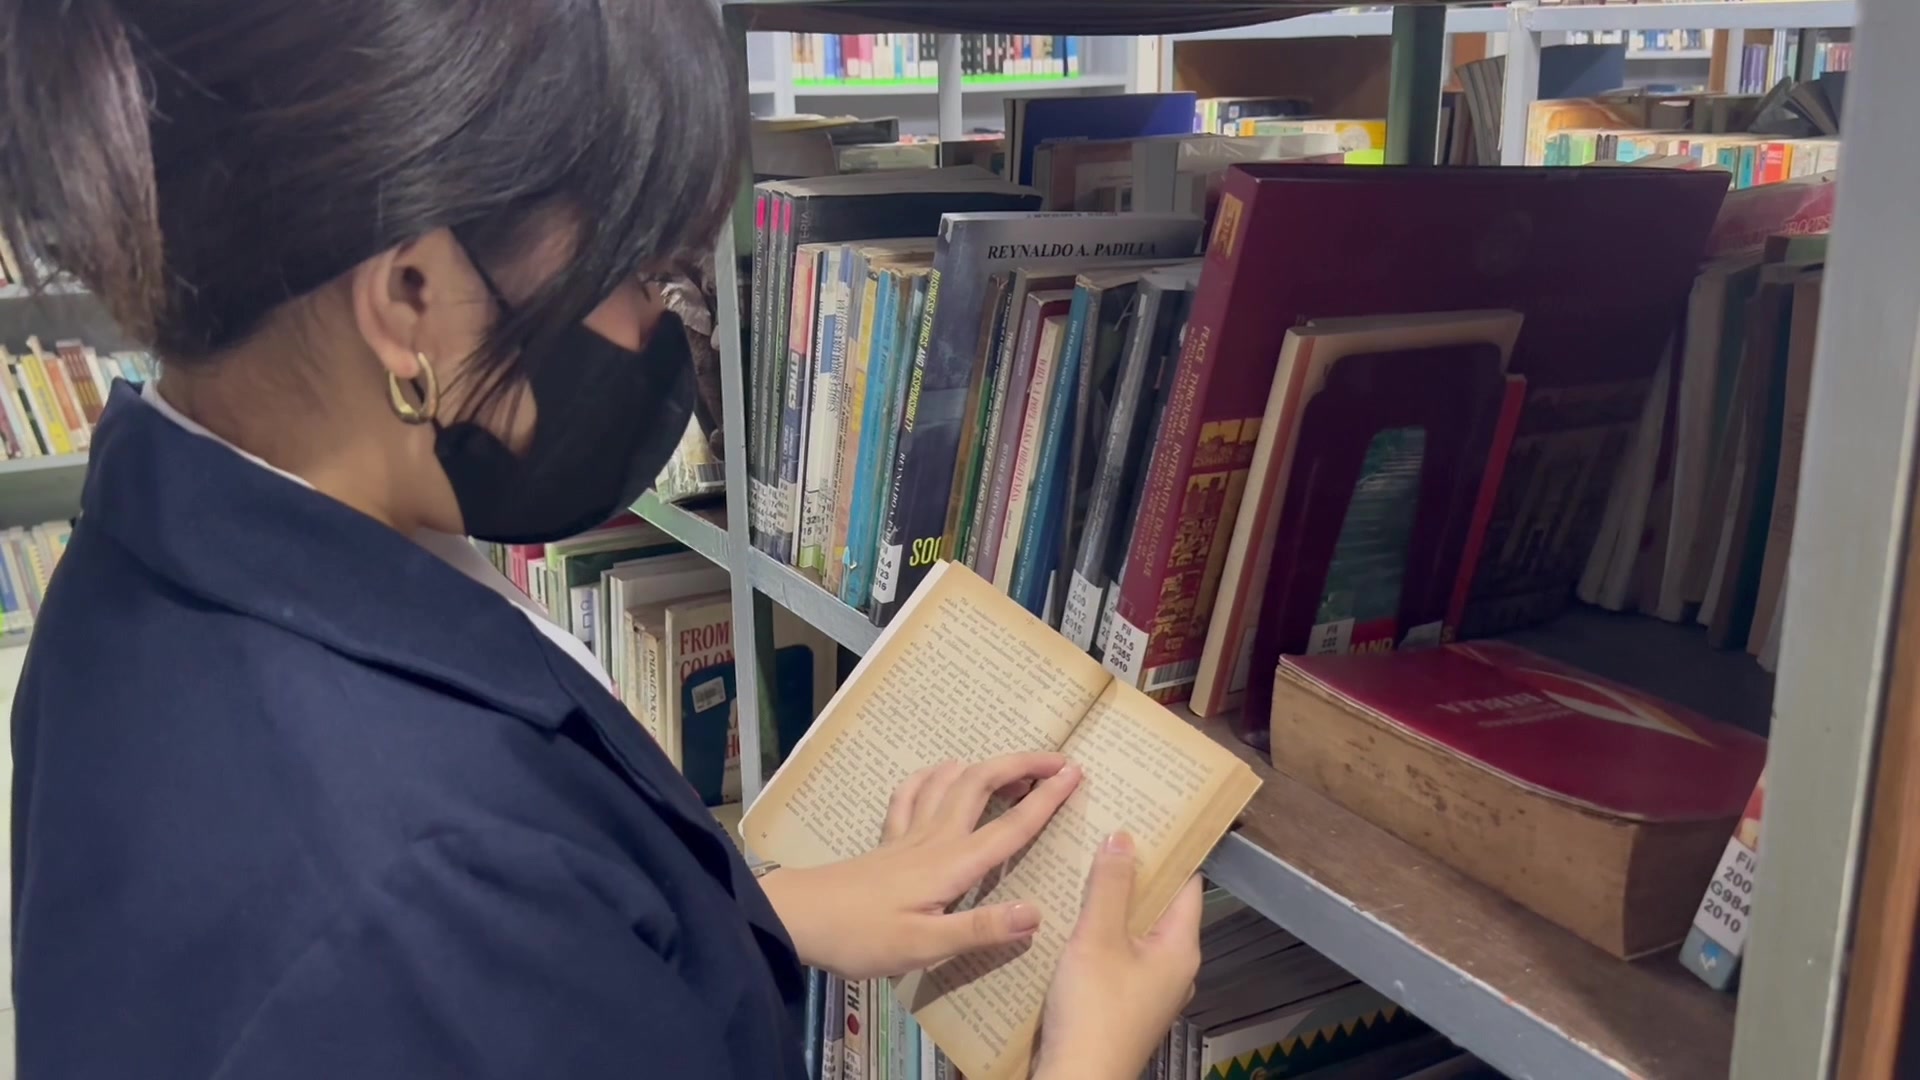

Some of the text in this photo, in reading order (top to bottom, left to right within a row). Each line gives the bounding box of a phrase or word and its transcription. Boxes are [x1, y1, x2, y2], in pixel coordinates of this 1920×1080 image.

[987, 242, 1157, 260] REYNALDO A. PADILLA
[925, 269, 940, 313] BUSINESS
[919, 314, 932, 347] ETHICS
[1004, 330, 1014, 349] THE
[915, 345, 927, 366] AND
[997, 350, 1010, 389] MERGING
[786, 351, 801, 408] ETHICS
[987, 390, 1002, 443] PHILOSOPHY
[1026, 397, 1040, 421] POPE
[984, 445, 993, 459] OF
[1141, 326, 1210, 578] PEACE THROUGH INTERFAITH DIALOGUE
[888, 452, 907, 508] REYNALDO
[980, 460, 990, 480] EAST
[977, 482, 986, 499] AND
[1078, 580, 1088, 592] Fil
[680, 621, 729, 656] FROM
[1122, 622, 1132, 636] Fil
[1110, 655, 1128, 673] 2010
[1711, 880, 1750, 917] G984
[1703, 898, 1741, 933] 2010
